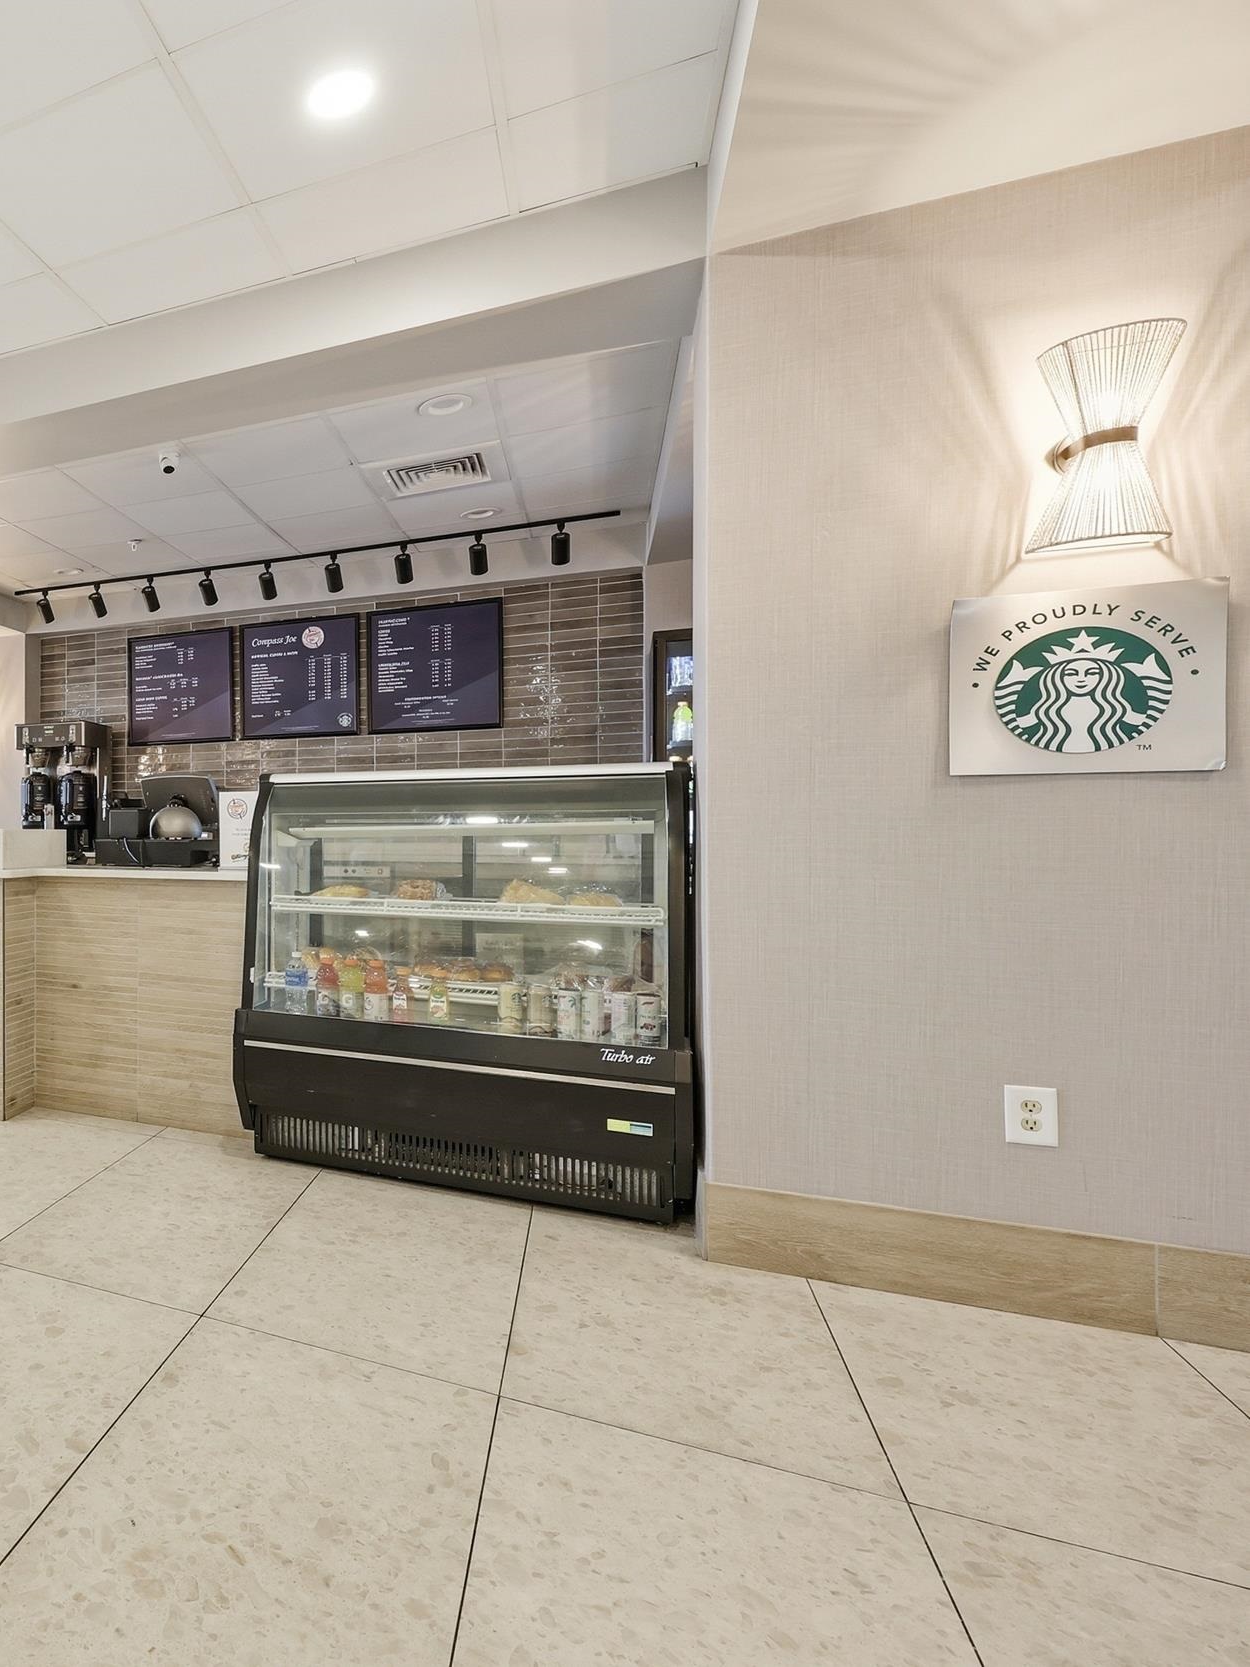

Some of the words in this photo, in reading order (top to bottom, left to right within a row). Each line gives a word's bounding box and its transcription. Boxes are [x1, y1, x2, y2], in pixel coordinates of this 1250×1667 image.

[251, 637, 283, 648] Compass
[284, 635, 298, 645] Joe
[972, 645, 1000, 672] WE
[1001, 603, 1121, 641] PROUDLY
[1130, 609, 1197, 658] SERVE
[600, 1048, 634, 1063] Turbo
[635, 1054, 656, 1065] air
